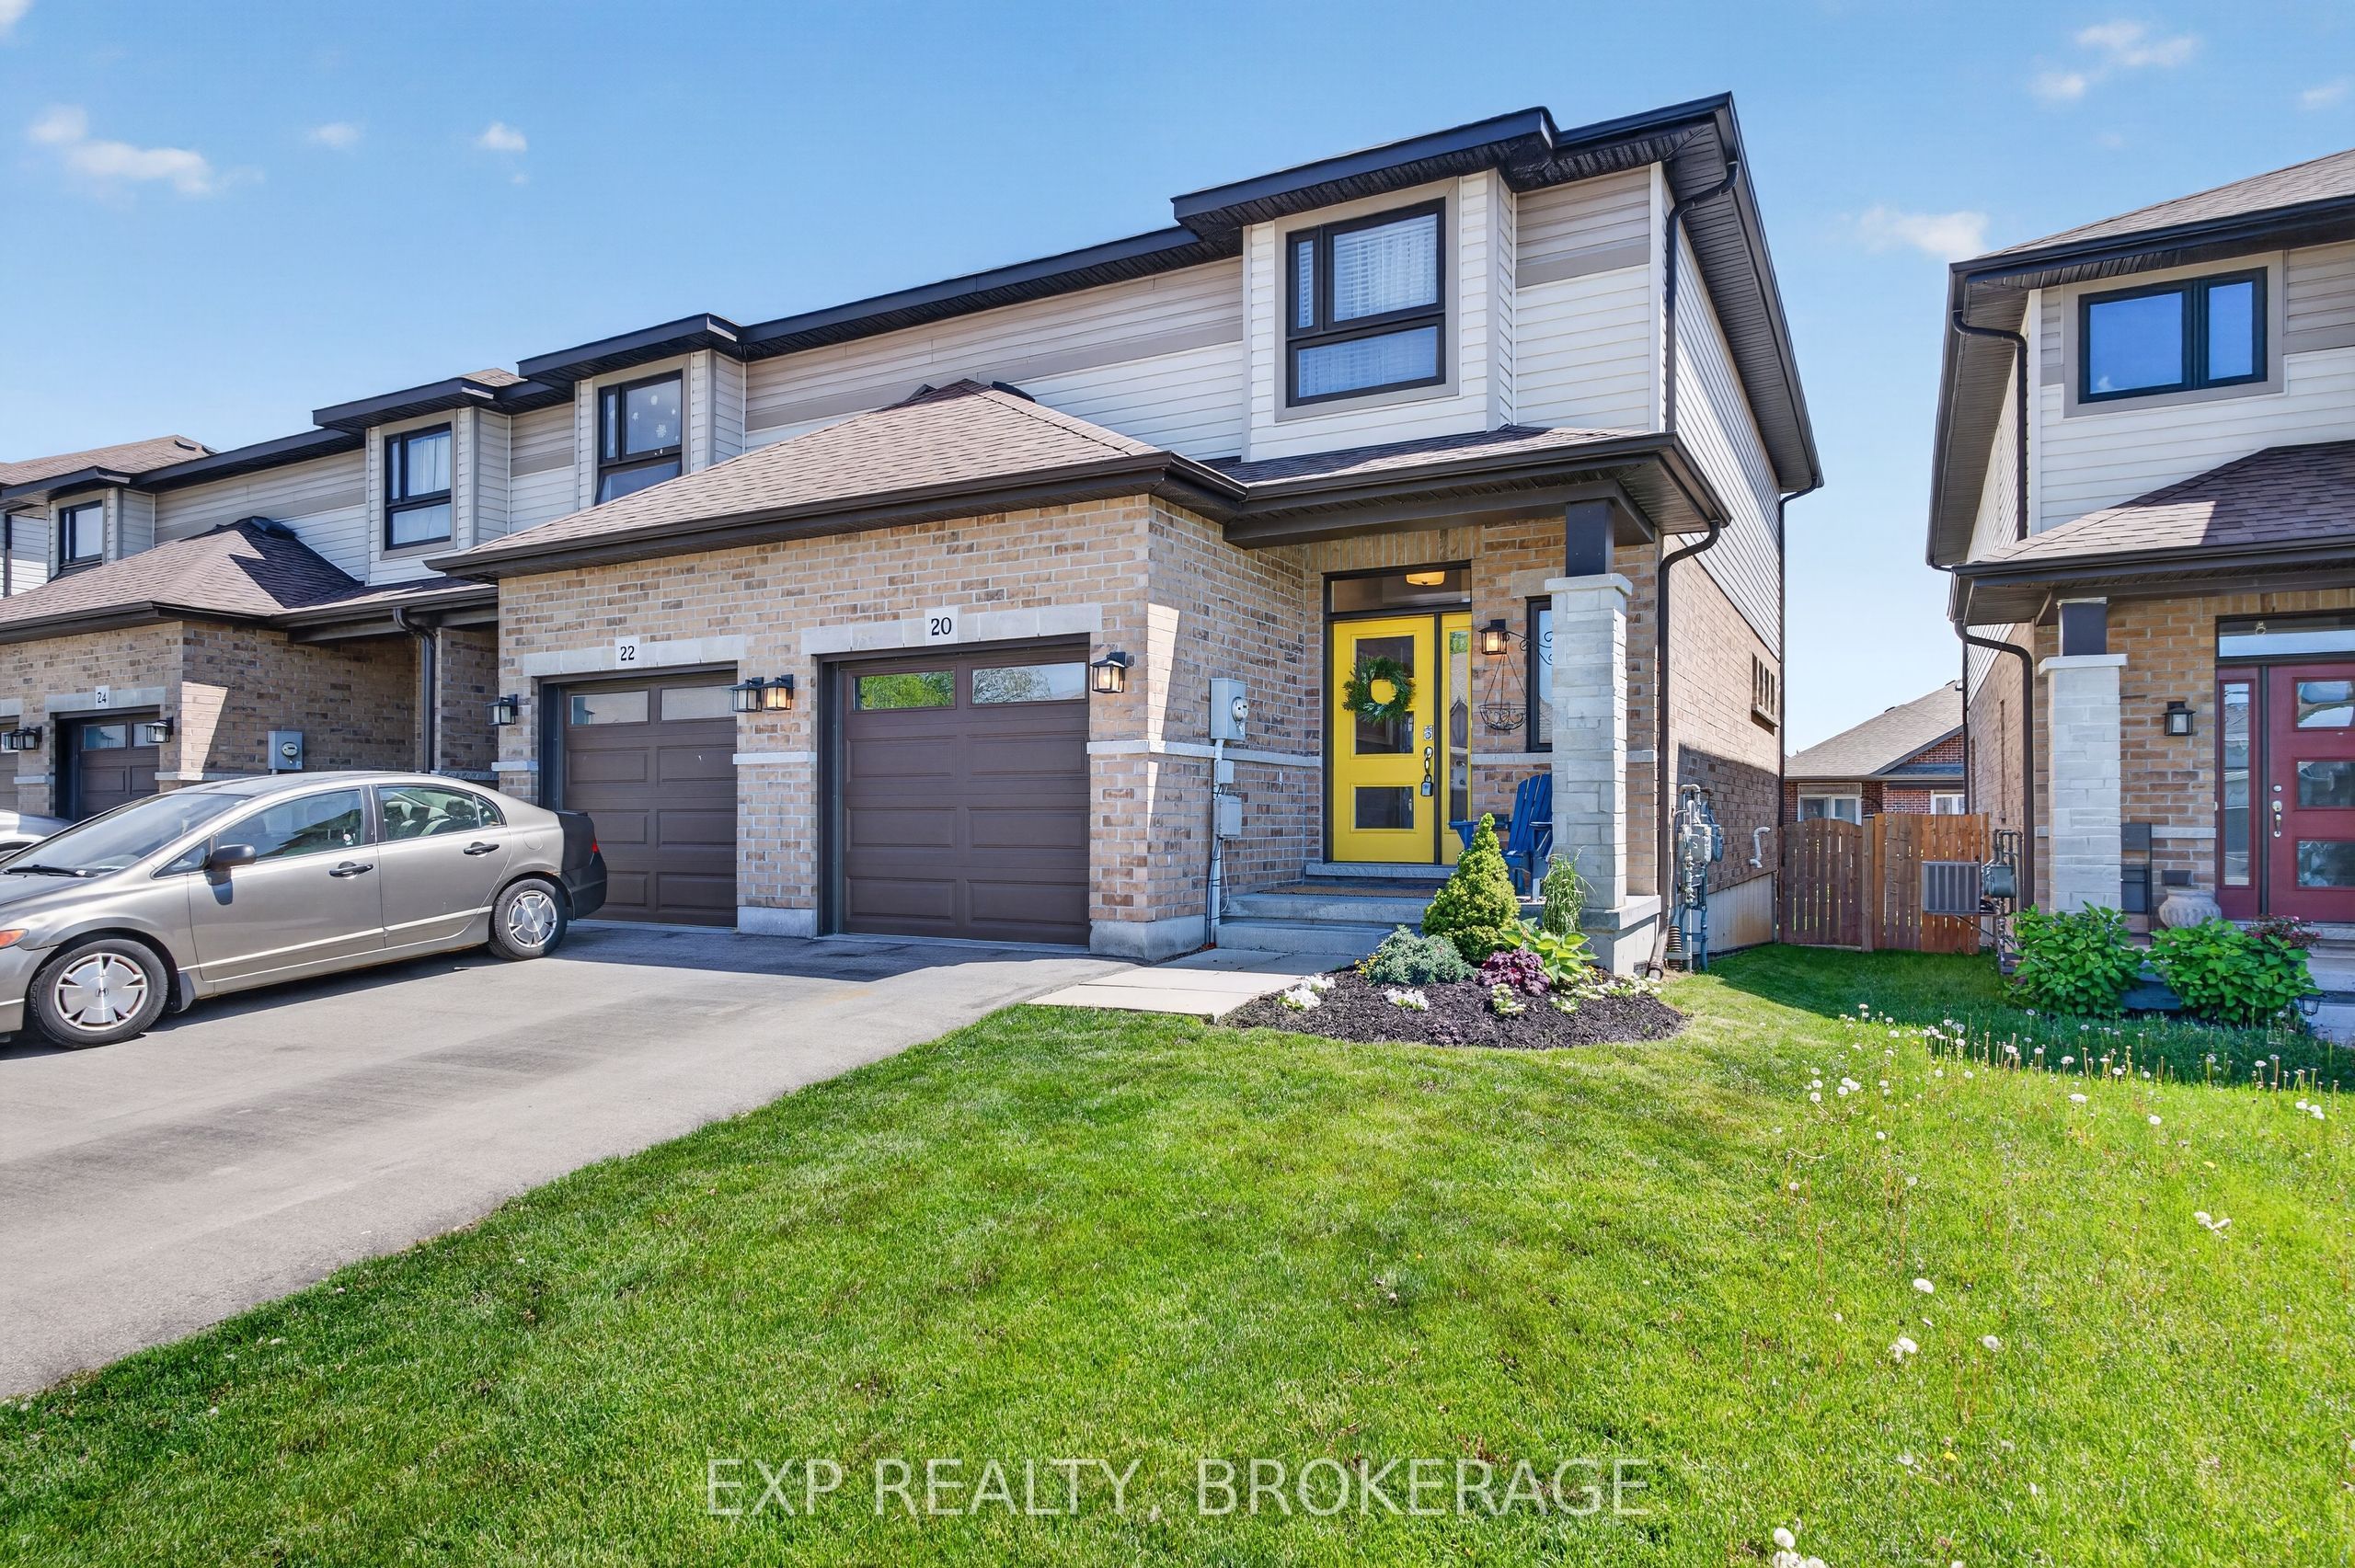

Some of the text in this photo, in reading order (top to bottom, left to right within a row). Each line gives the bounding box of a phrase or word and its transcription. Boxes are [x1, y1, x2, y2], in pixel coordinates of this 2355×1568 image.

[931, 616, 952, 635] 20
[620, 645, 635, 661] 22
[97, 692, 107, 704] 24
